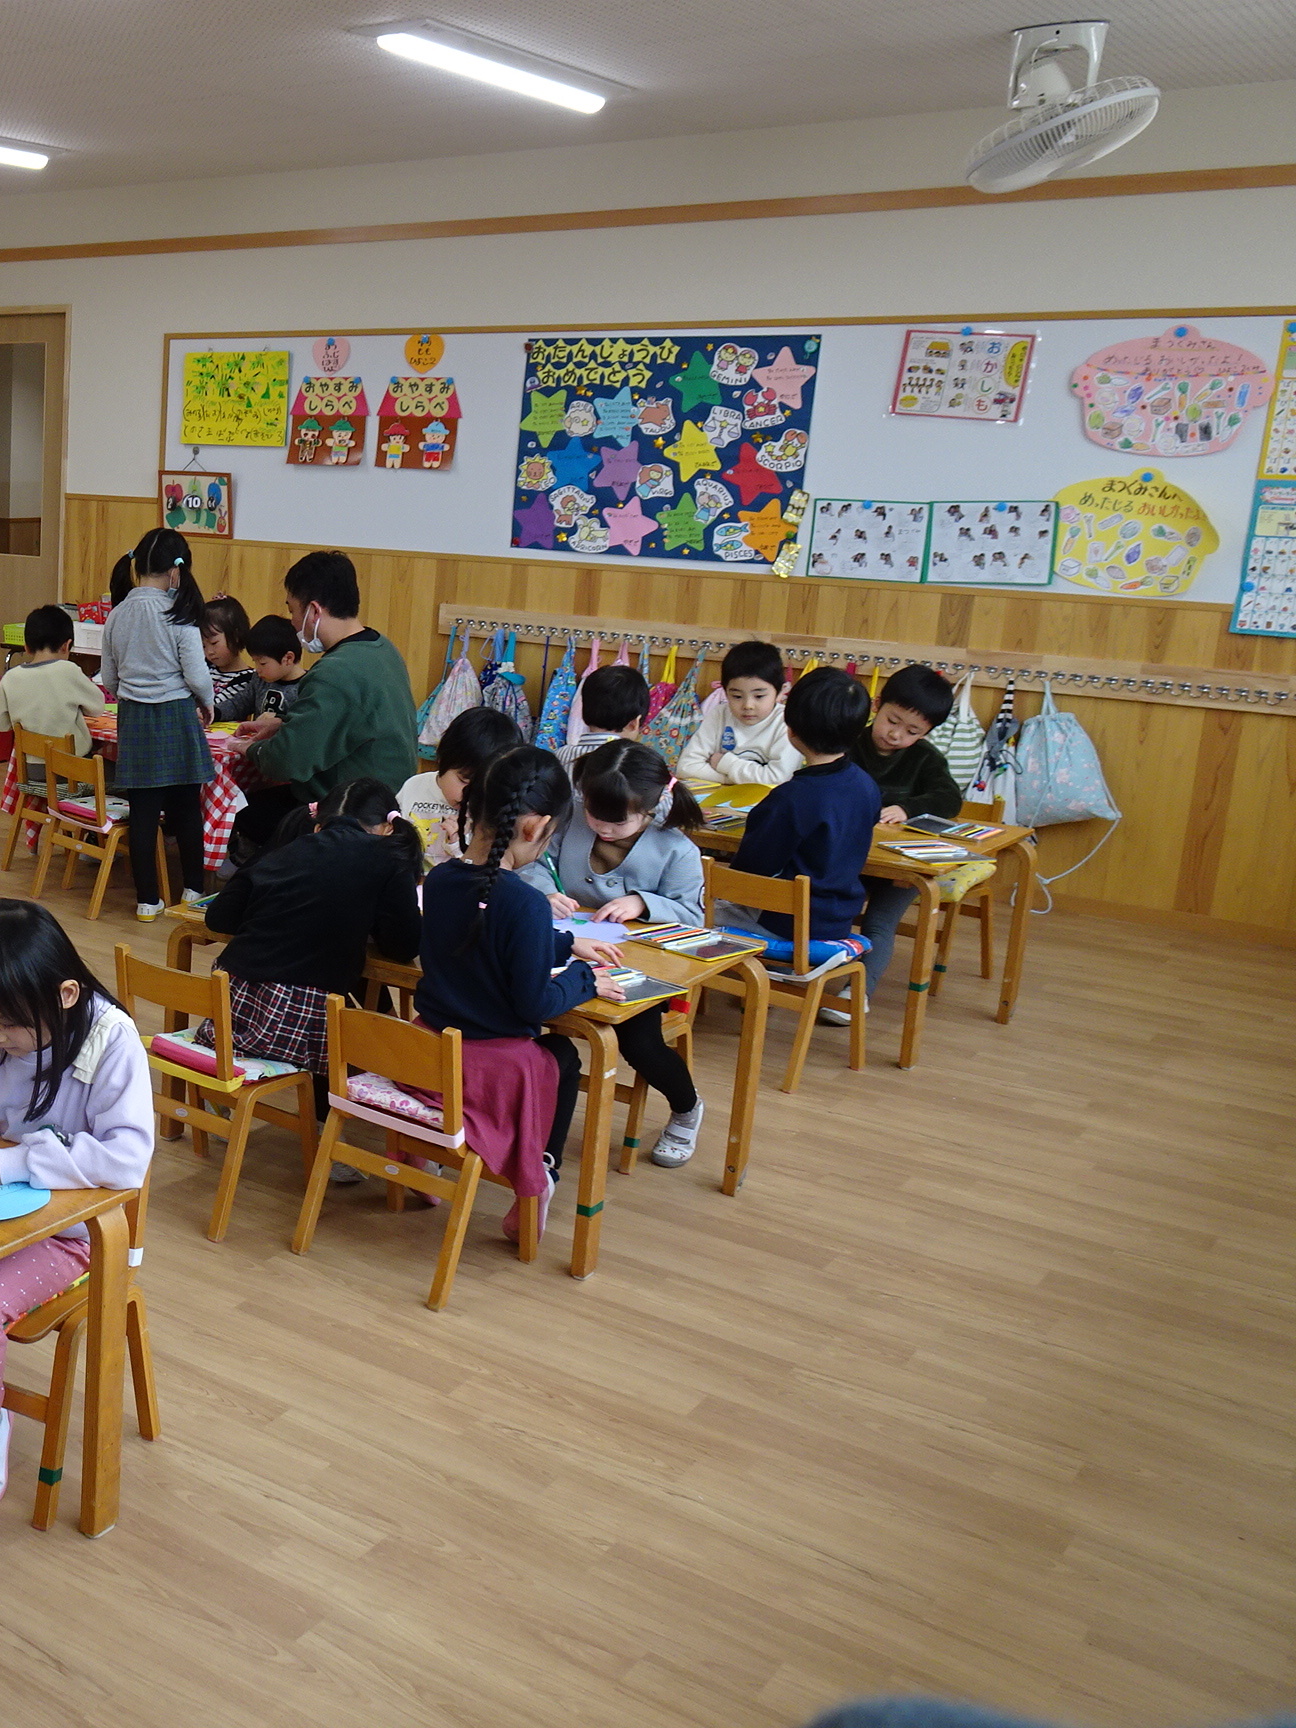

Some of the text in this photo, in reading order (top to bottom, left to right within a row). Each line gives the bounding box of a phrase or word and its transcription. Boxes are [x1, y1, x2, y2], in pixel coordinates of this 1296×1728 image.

[531, 343, 674, 361] おたんじょうび
[541, 366, 646, 385] おめでとう
[710, 369, 748, 384] GEMINI
[304, 381, 360, 393] おやすみ
[392, 381, 451, 394] おやすみ
[309, 399, 353, 412] しらべ
[399, 400, 446, 413] しらべ
[712, 406, 742, 421] LIBRA
[644, 420, 676, 434] TAURUS
[742, 415, 784, 429] CANCER
[757, 454, 803, 471] SCORPIO
[550, 486, 595, 504] SAGITTARIUS
[650, 487, 674, 496] VIRGO
[695, 479, 733, 506] AQUARIUS
[167, 497, 173, 509] 2
[186, 496, 201, 508] 10
[1078, 491, 1134, 513] めったじる
[724, 549, 753, 559] PISCES
